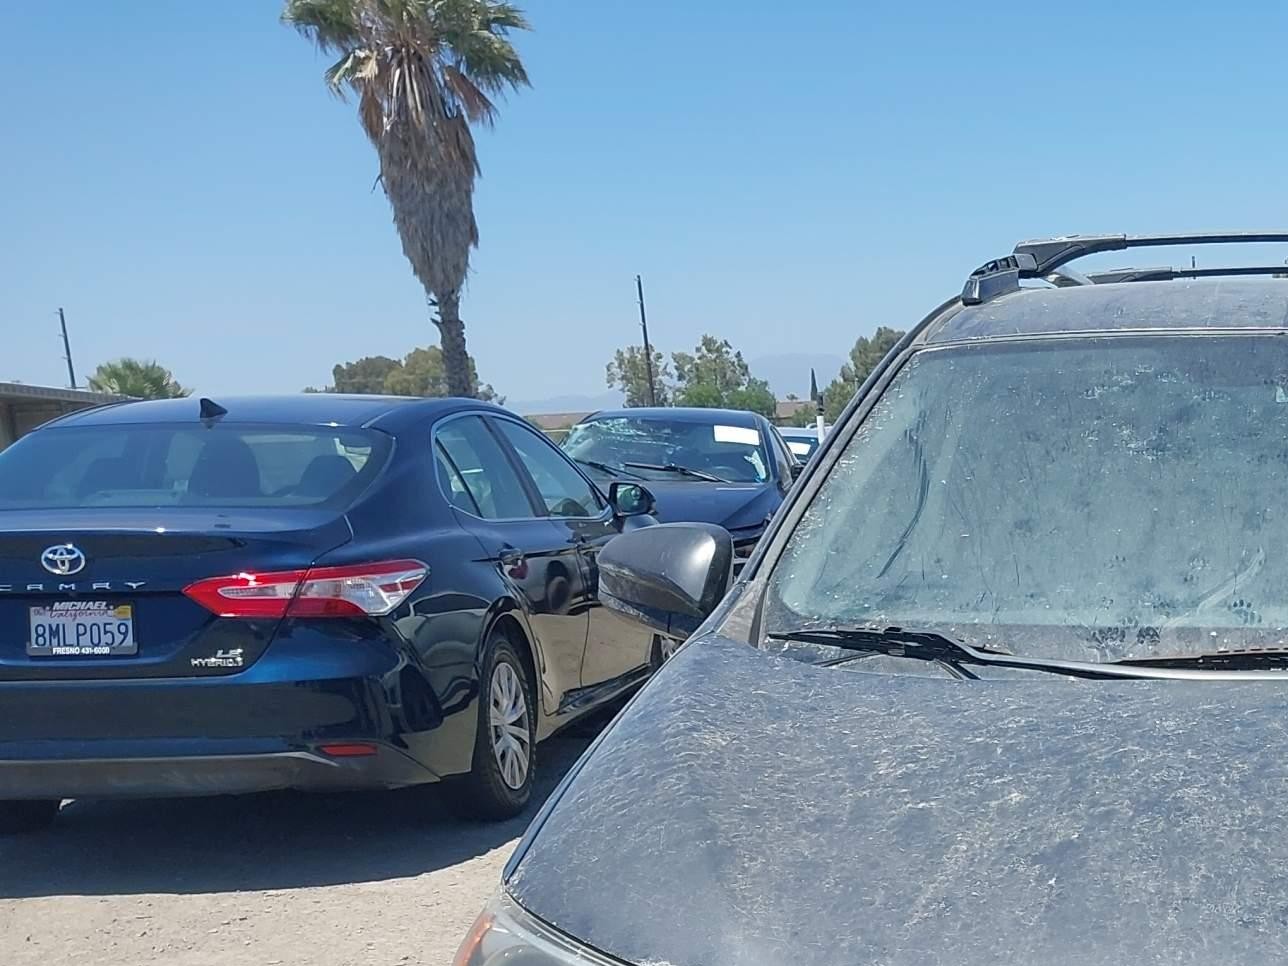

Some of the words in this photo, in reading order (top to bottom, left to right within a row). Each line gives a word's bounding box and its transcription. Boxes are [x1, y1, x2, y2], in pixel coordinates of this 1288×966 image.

[0, 582, 146, 591] CAMRY
[53, 600, 108, 610] MICHAEL
[34, 622, 129, 647] 8MLP059
[52, 646, 80, 655] FRESNO
